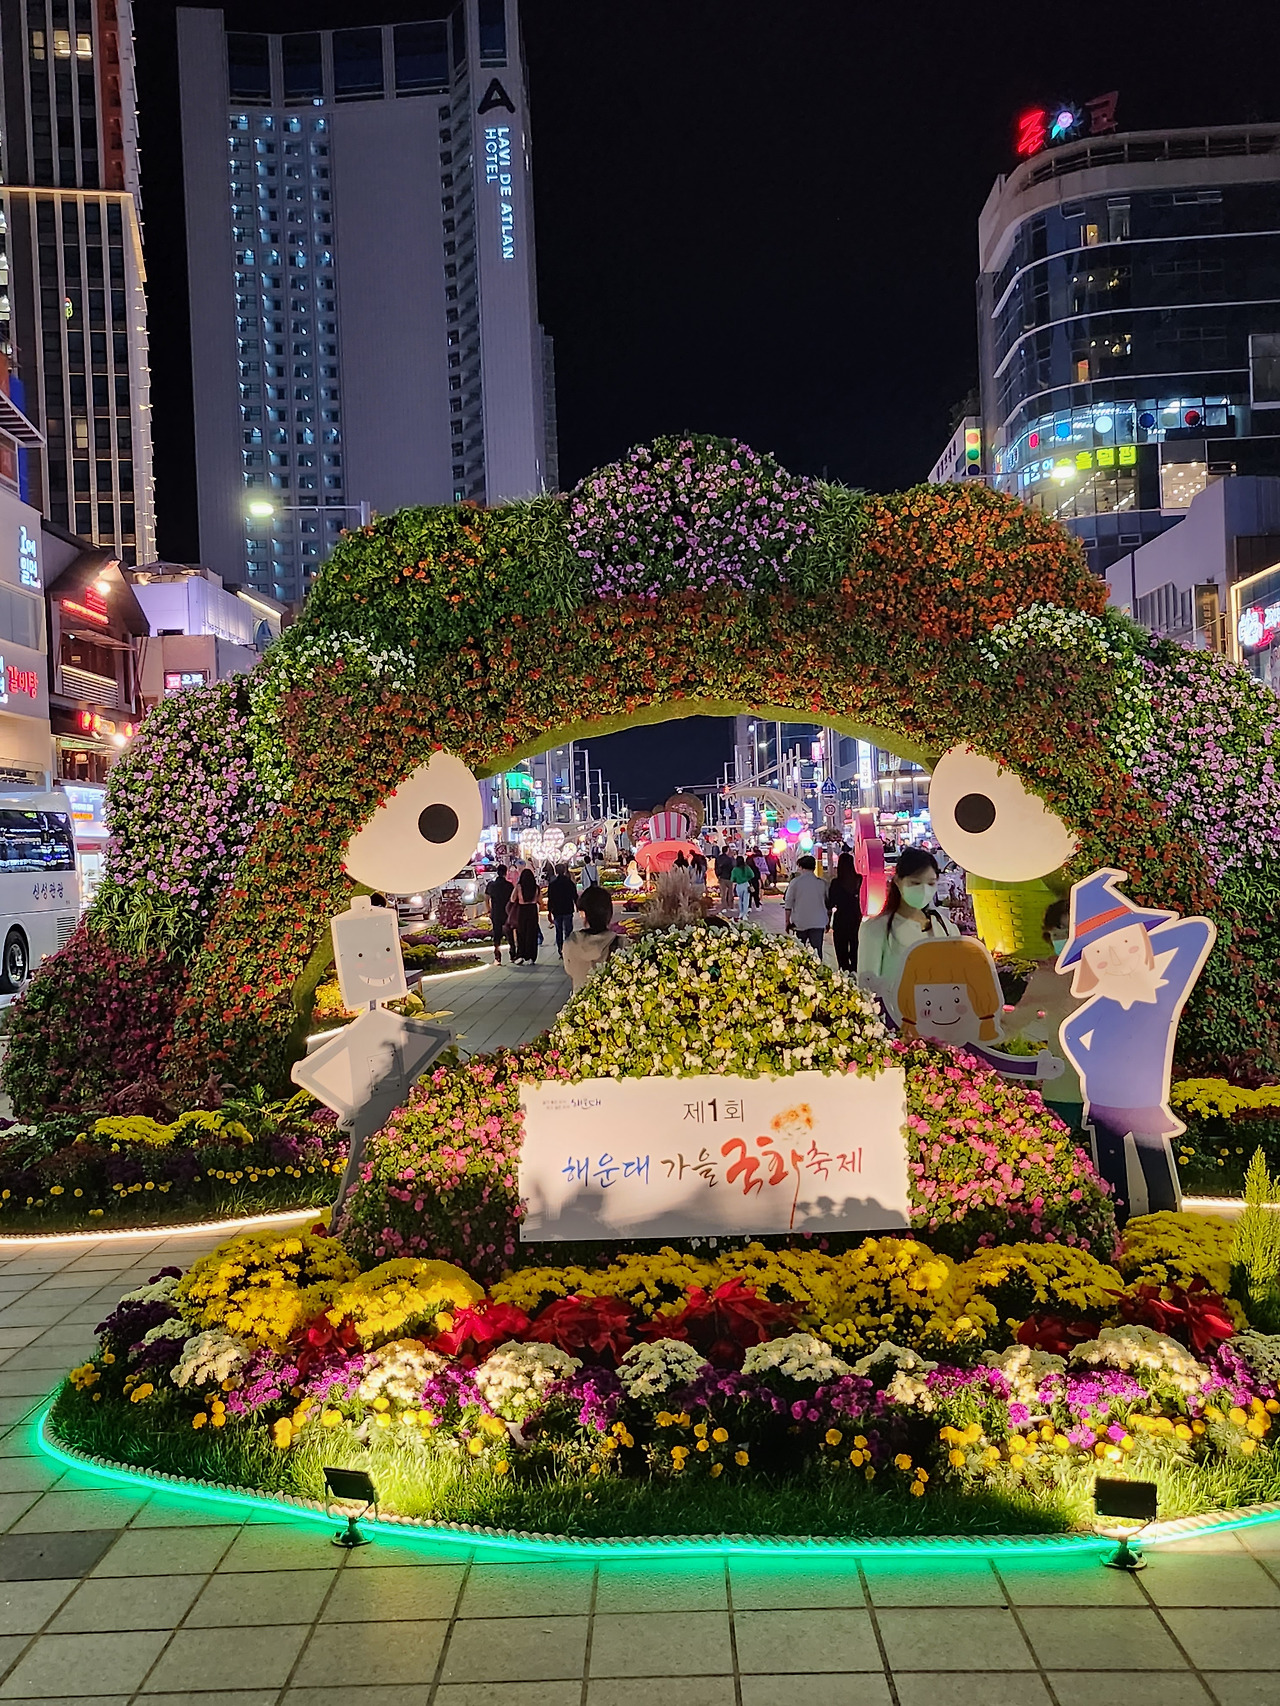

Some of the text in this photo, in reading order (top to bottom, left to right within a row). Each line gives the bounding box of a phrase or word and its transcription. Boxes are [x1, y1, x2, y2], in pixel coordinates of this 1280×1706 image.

[484, 128, 498, 184] HOTEL
[497, 126, 515, 260] LAVI DE ATLAN
[6, 665, 39, 699] 갈비탕
[32, 881, 64, 901] 신성관광
[683, 1098, 745, 1124] 제1회
[561, 1152, 650, 1189] 해운대
[660, 1146, 719, 1188] 가을
